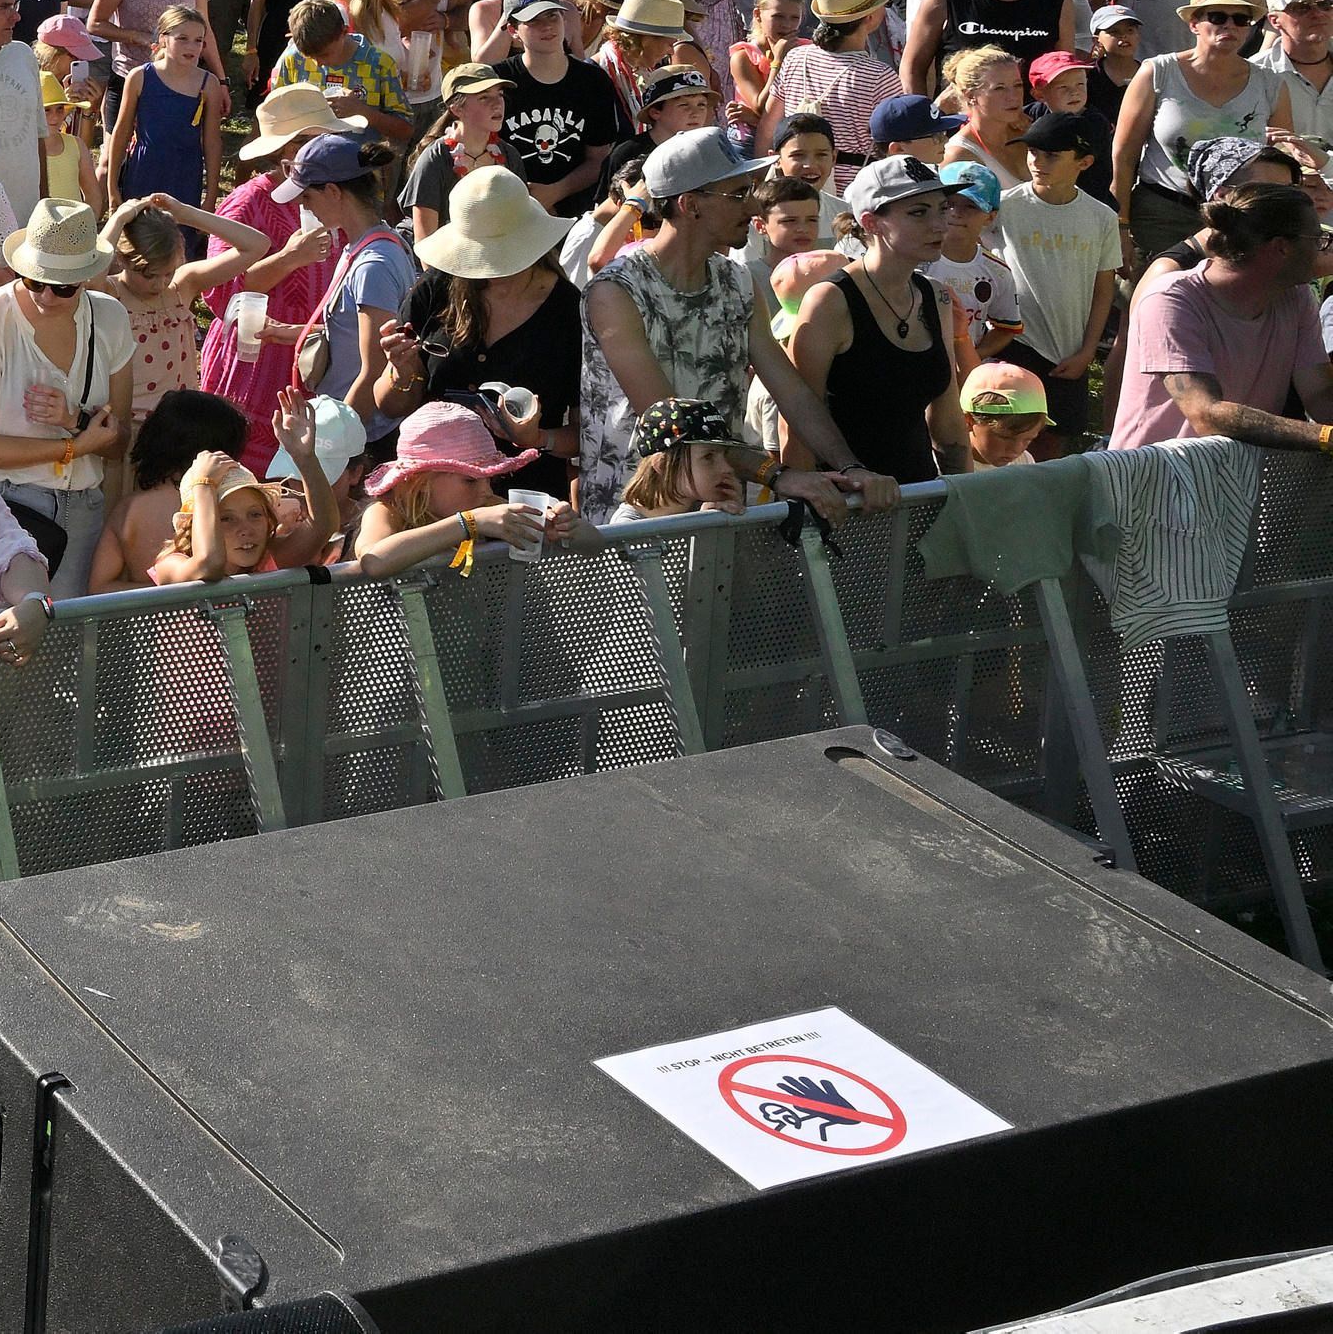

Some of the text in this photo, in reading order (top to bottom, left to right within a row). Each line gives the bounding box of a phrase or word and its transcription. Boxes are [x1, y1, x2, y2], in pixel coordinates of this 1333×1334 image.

[958, 21, 1049, 42] Champion
[506, 108, 586, 134] KASALLA
[671, 1058, 701, 1071] STOP
[710, 1049, 747, 1063] NICHT
[745, 1034, 806, 1055] BETRETEN
